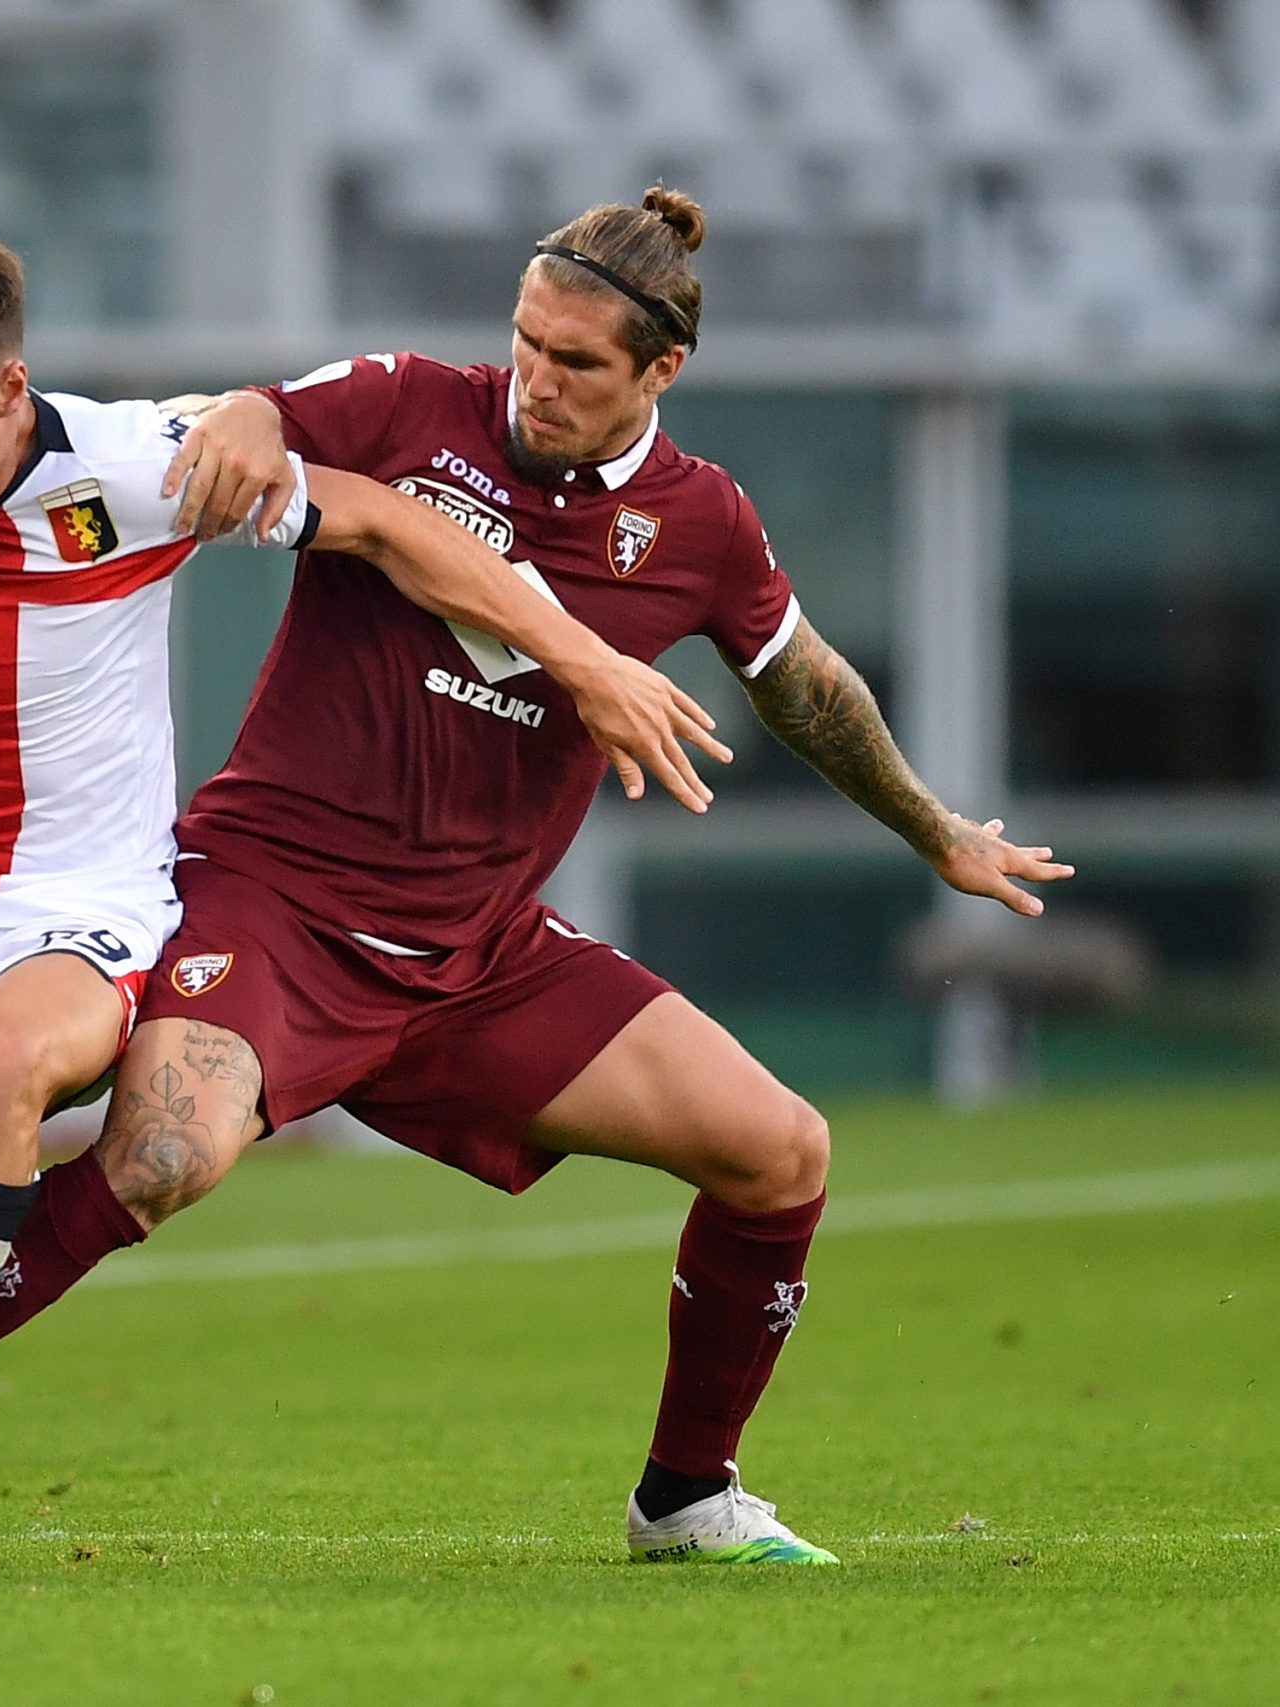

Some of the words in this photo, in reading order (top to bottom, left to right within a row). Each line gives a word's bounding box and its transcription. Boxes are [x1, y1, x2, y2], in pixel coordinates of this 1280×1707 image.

[431, 448, 511, 506] Joma
[621, 514, 653, 535] TORINO
[635, 536, 649, 549] FC
[424, 668, 546, 728] SUZUKI
[184, 958, 224, 967] TORINO
[644, 1538, 699, 1560] NEMESIS
